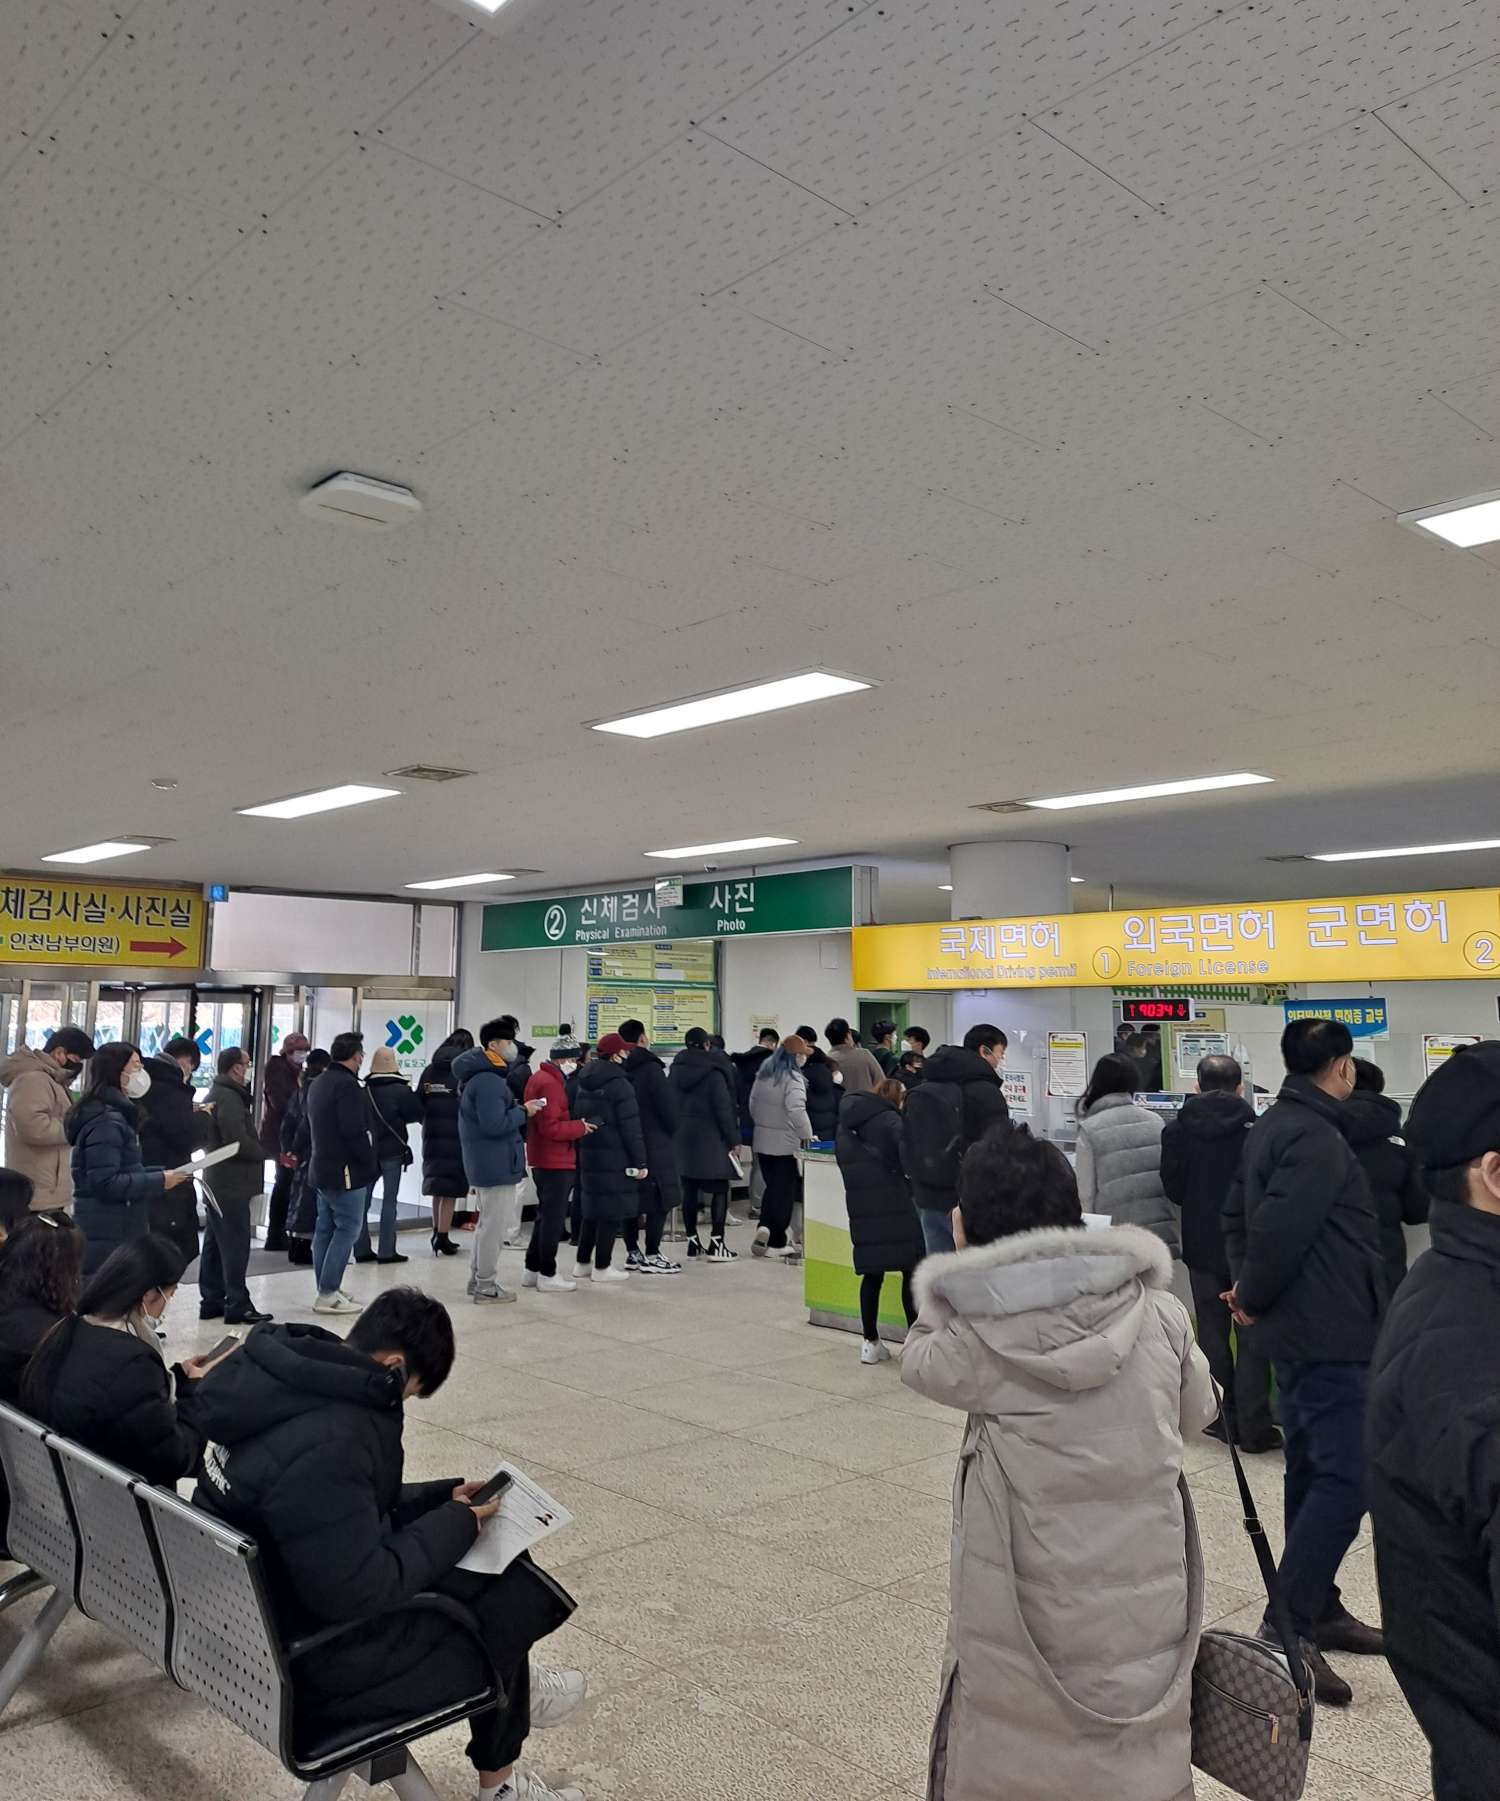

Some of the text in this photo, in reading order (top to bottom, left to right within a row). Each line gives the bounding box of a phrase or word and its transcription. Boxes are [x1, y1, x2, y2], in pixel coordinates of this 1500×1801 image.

[709, 882, 755, 914] 사진
[580, 892, 661, 925] 신체검사
[575, 925, 667, 942] Physical Examination
[716, 919, 746, 932] Photo
[1123, 899, 1448, 953] 외국면허 군면허
[10, 932, 120, 954] 인천남부의원)
[940, 921, 1060, 960] 국제면허
[927, 966, 994, 979] International
[997, 965, 1036, 981] Driving
[1127, 958, 1269, 977] Foreign License
[1138, 1003, 1174, 1017] 9034
[1334, 1008, 1362, 1025] 면허증
[1365, 1008, 1384, 1024] 교부
